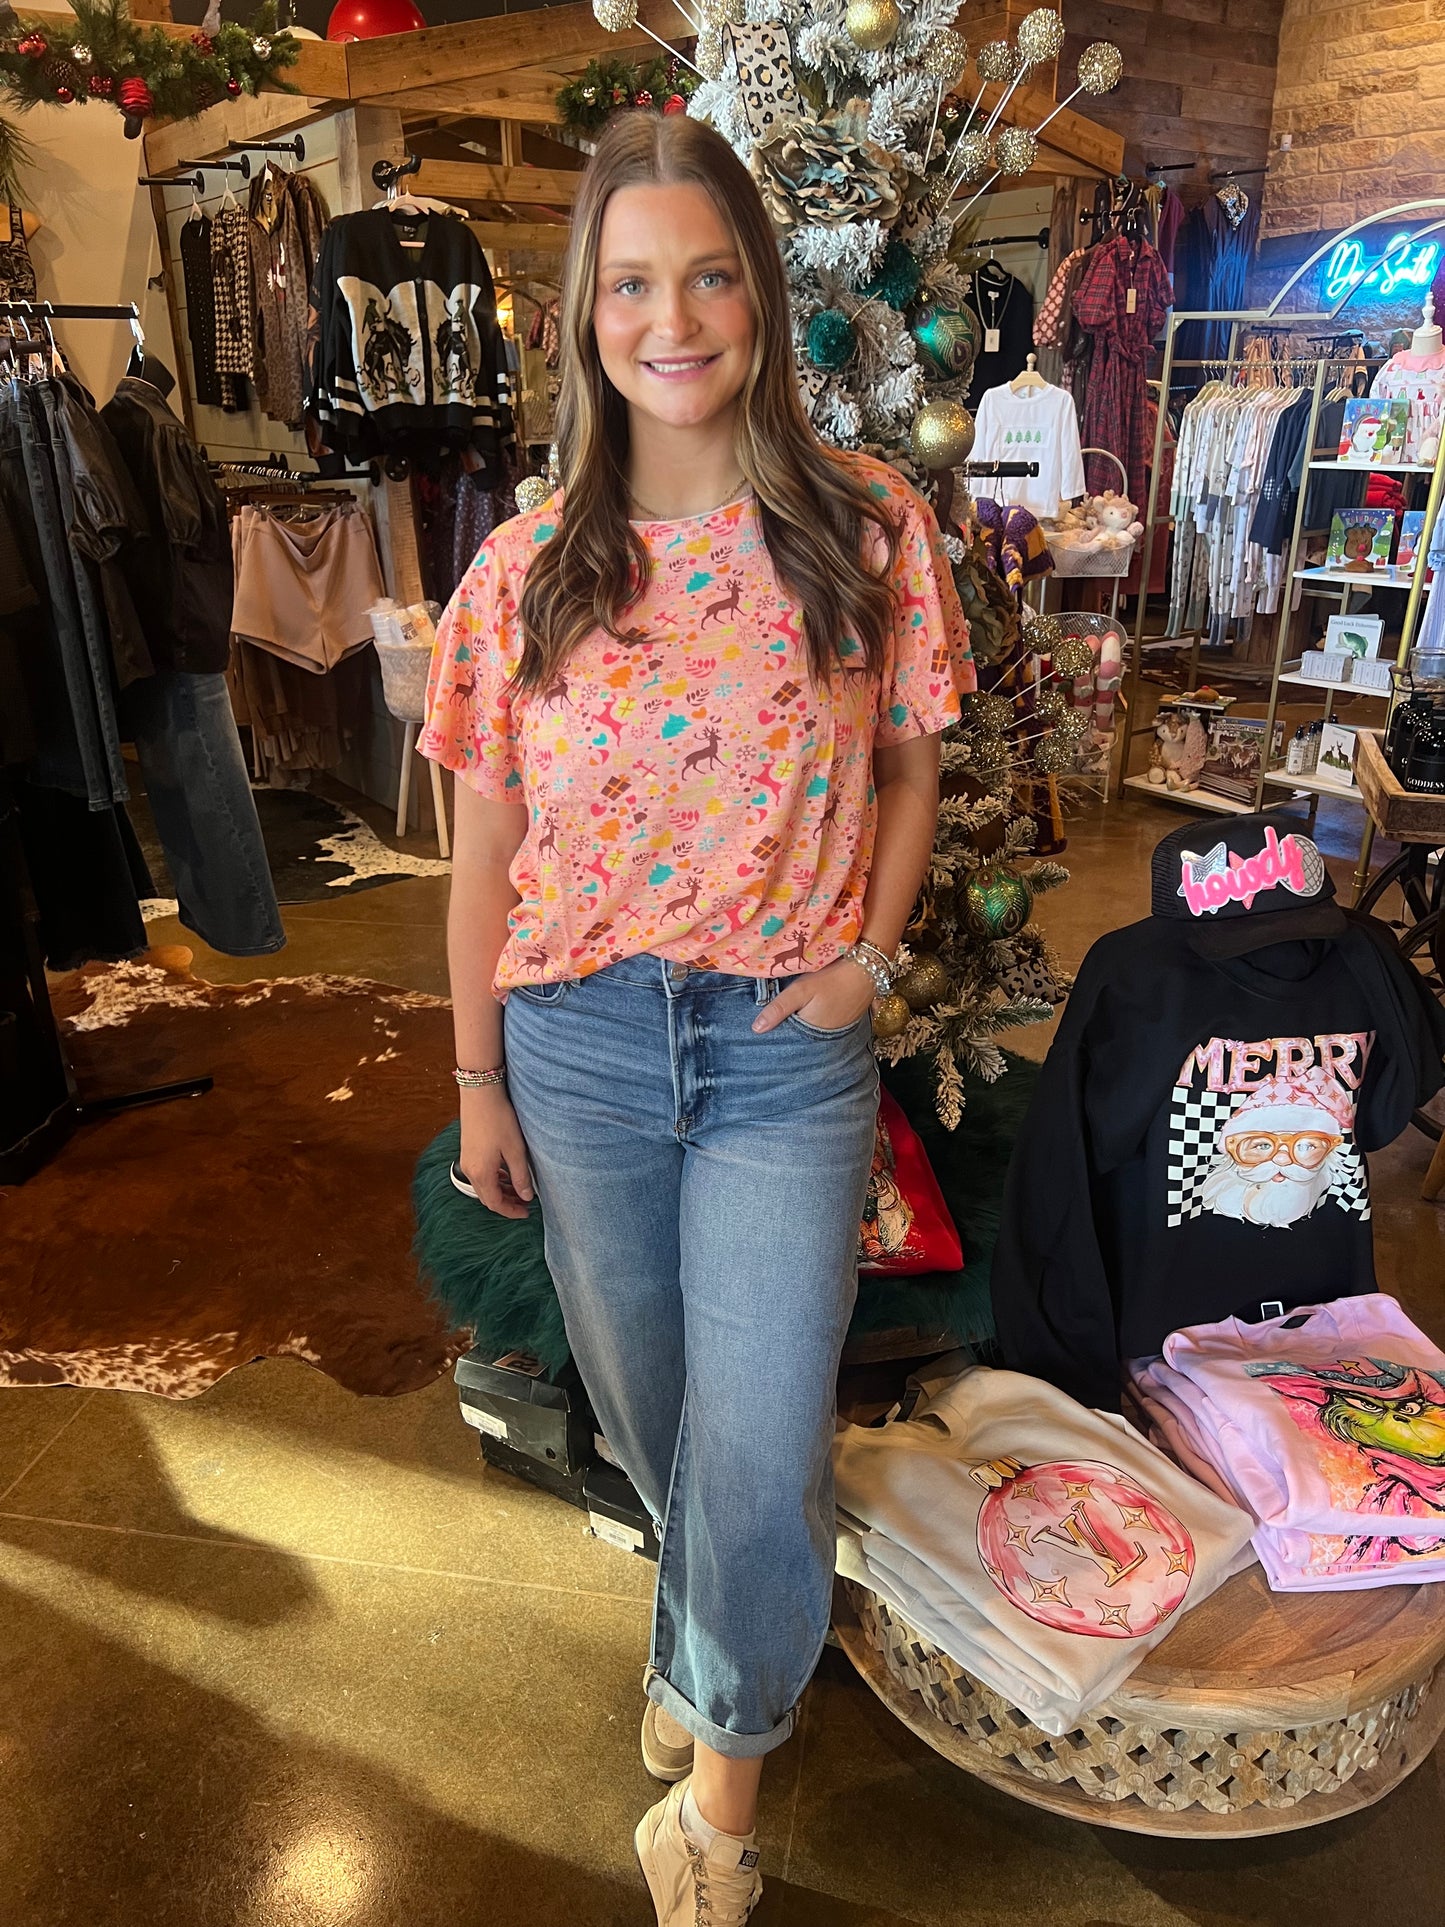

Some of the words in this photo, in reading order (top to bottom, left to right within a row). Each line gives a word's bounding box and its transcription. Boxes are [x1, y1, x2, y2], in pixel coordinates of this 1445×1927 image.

[1407, 777, 1445, 788] GODDESS
[1182, 826, 1306, 916] howdy
[1175, 1030, 1377, 1093] MERRY
